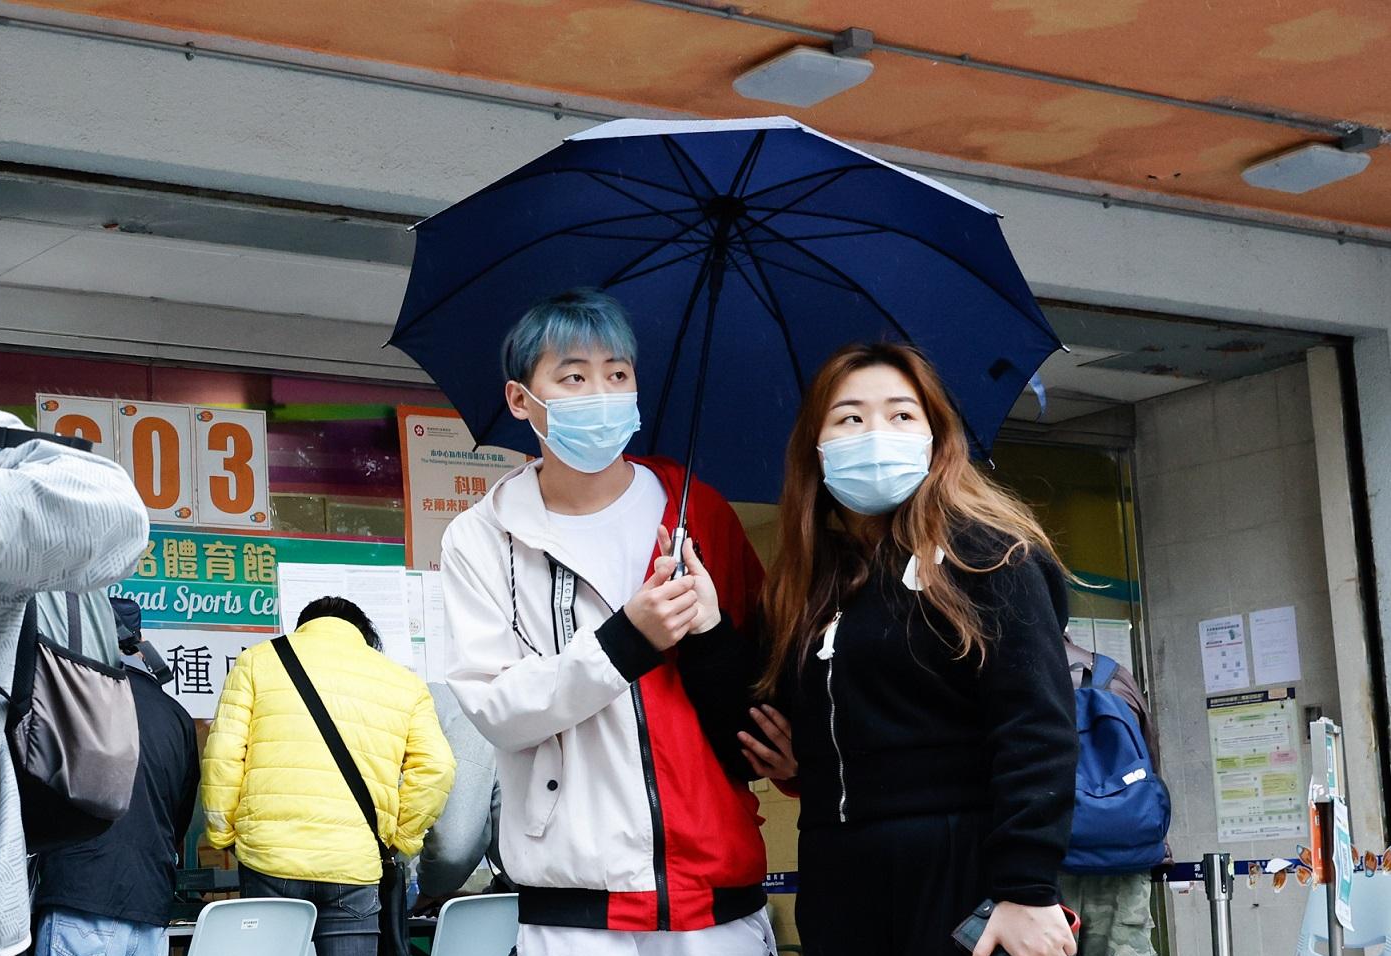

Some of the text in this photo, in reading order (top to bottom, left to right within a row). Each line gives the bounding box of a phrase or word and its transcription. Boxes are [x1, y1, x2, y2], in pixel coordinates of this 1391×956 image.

[55, 414, 255, 514] 03
[454, 476, 487, 496] 科興
[423, 498, 469, 513] 克爾來福
[173, 585, 245, 619] Sports
[167, 644, 249, 696] 種
